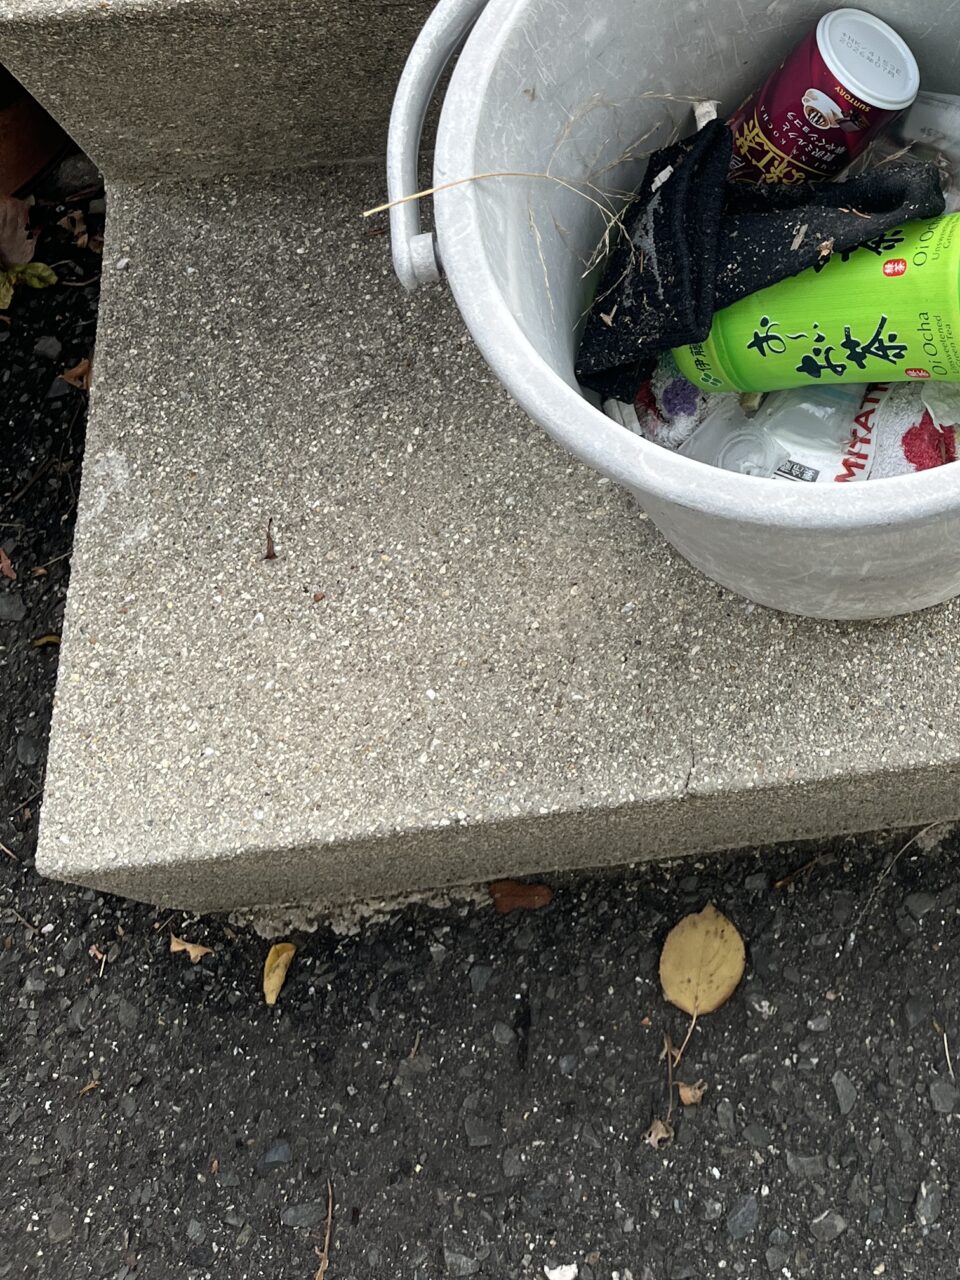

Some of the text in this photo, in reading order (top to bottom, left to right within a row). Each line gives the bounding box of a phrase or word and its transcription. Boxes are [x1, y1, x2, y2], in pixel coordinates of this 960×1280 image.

[834, 85, 872, 112] SUNTORY
[760, 104, 787, 145] KOCHA
[912, 245, 930, 267] Oi
[916, 311, 938, 357] Ocha
[928, 359, 948, 376] Oi
